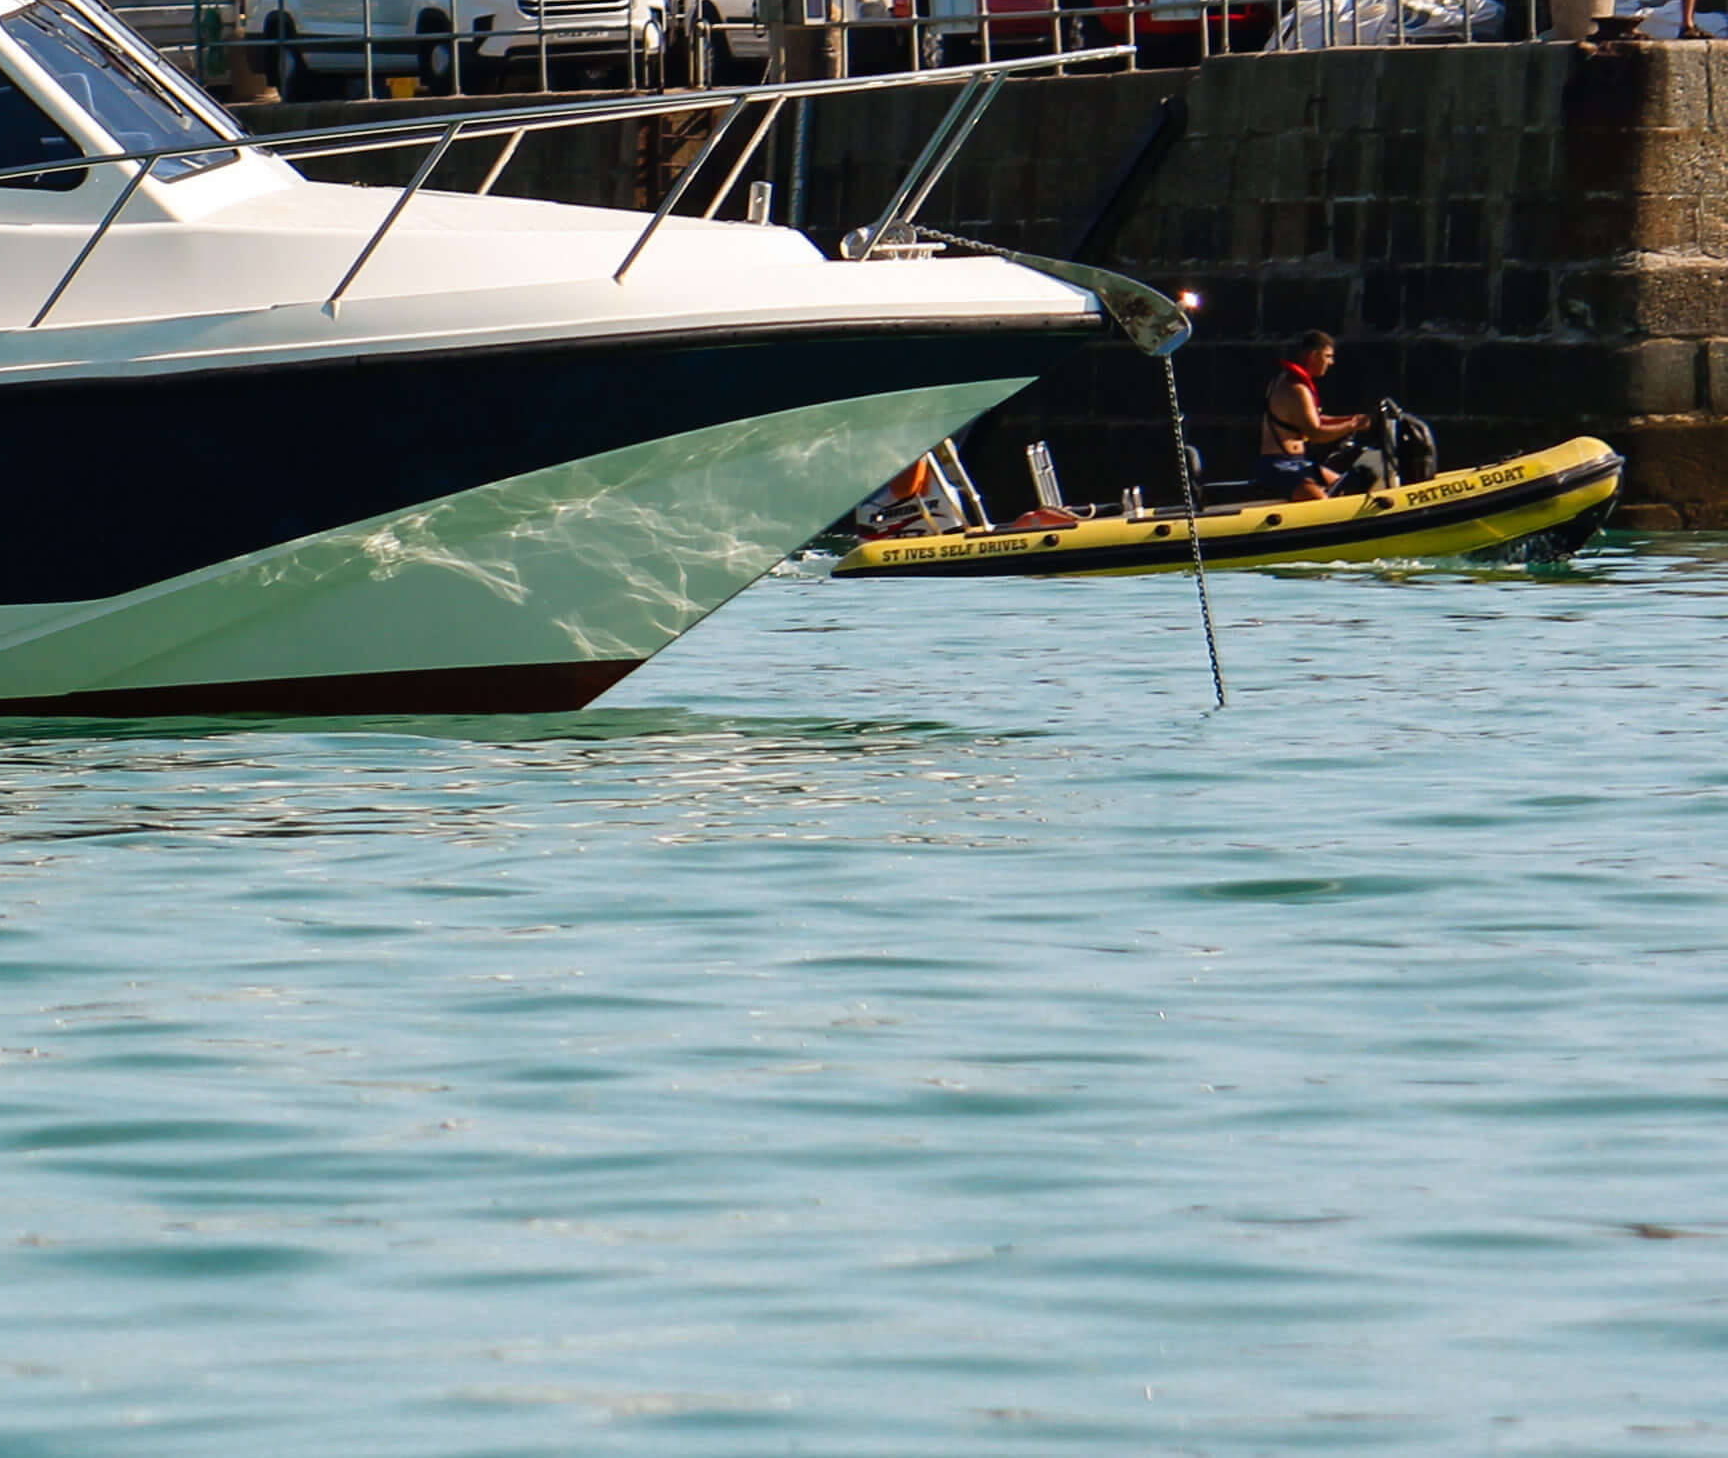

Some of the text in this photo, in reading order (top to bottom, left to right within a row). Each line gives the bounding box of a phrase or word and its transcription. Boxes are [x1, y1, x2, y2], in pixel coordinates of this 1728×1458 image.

[1406, 466, 1525, 505] PATROL BOAT
[883, 538, 1029, 562] ST IVES SELF DRIVES
